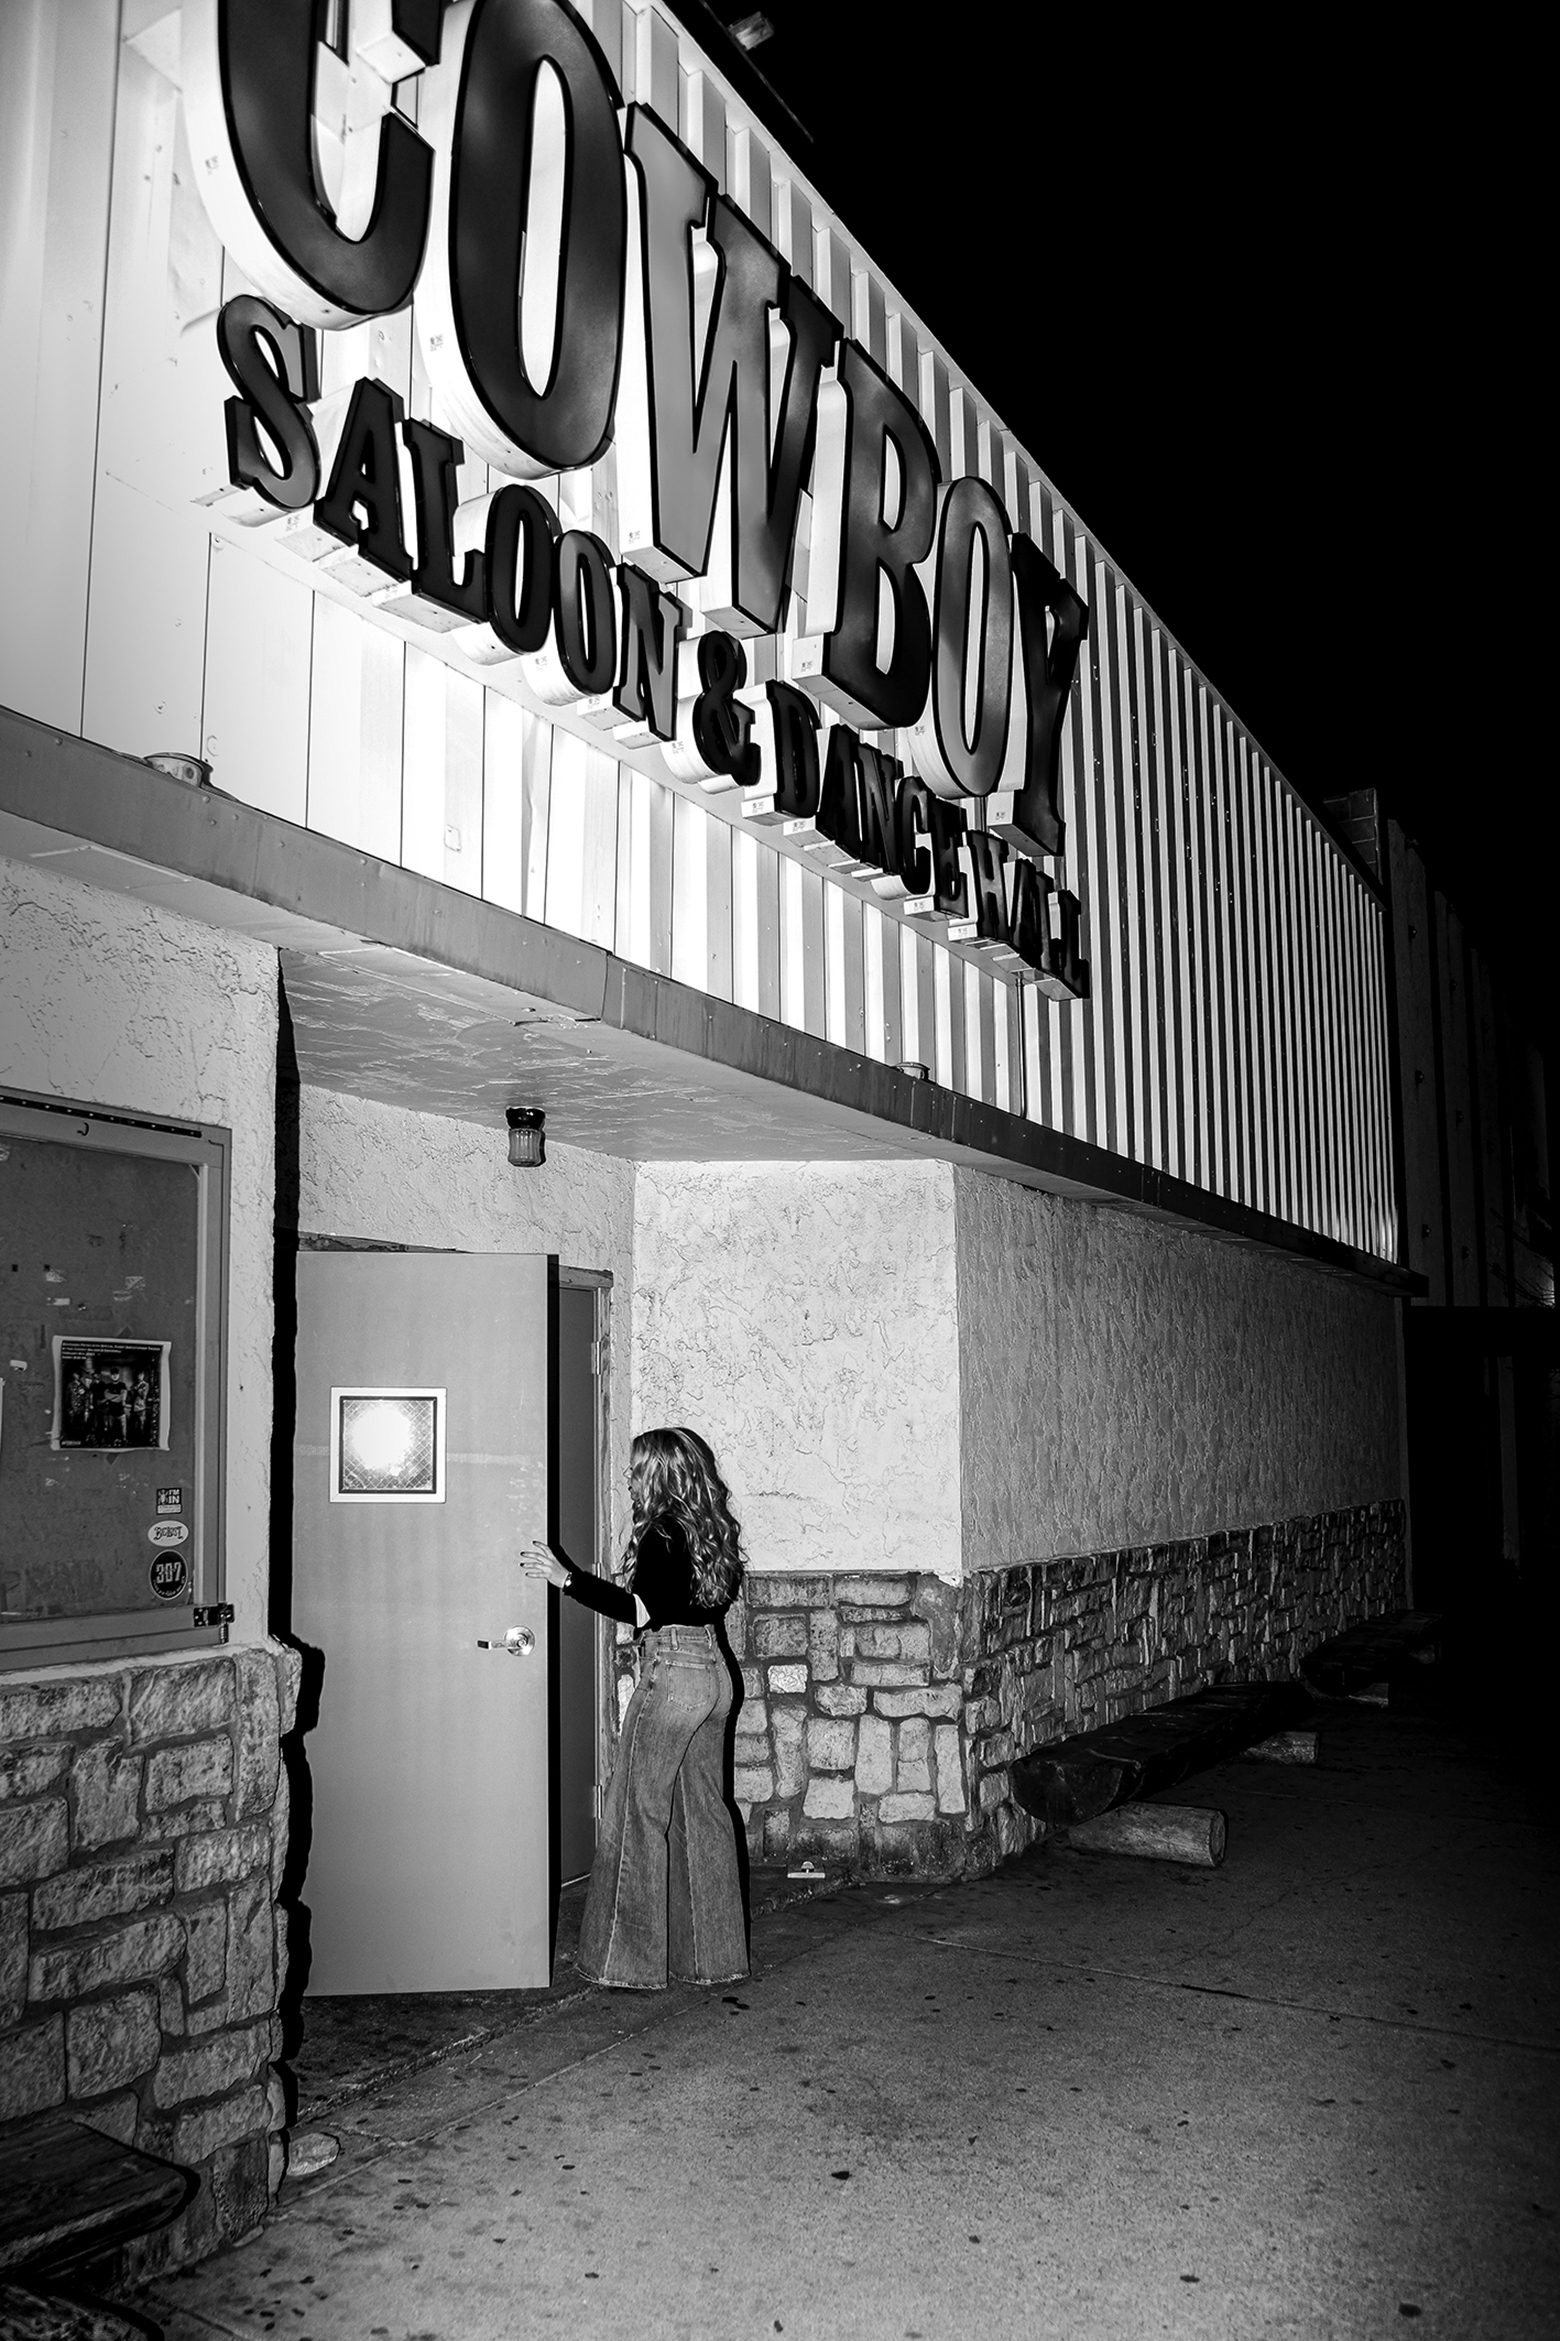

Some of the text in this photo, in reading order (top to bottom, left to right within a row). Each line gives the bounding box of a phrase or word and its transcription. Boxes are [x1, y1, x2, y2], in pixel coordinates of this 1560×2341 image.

[217, 0, 1088, 857] COWBOY
[217, 294, 692, 741] SALOON
[693, 630, 761, 786] &
[156, 1561, 182, 1584] 307
[168, 1495, 180, 1504] IN
